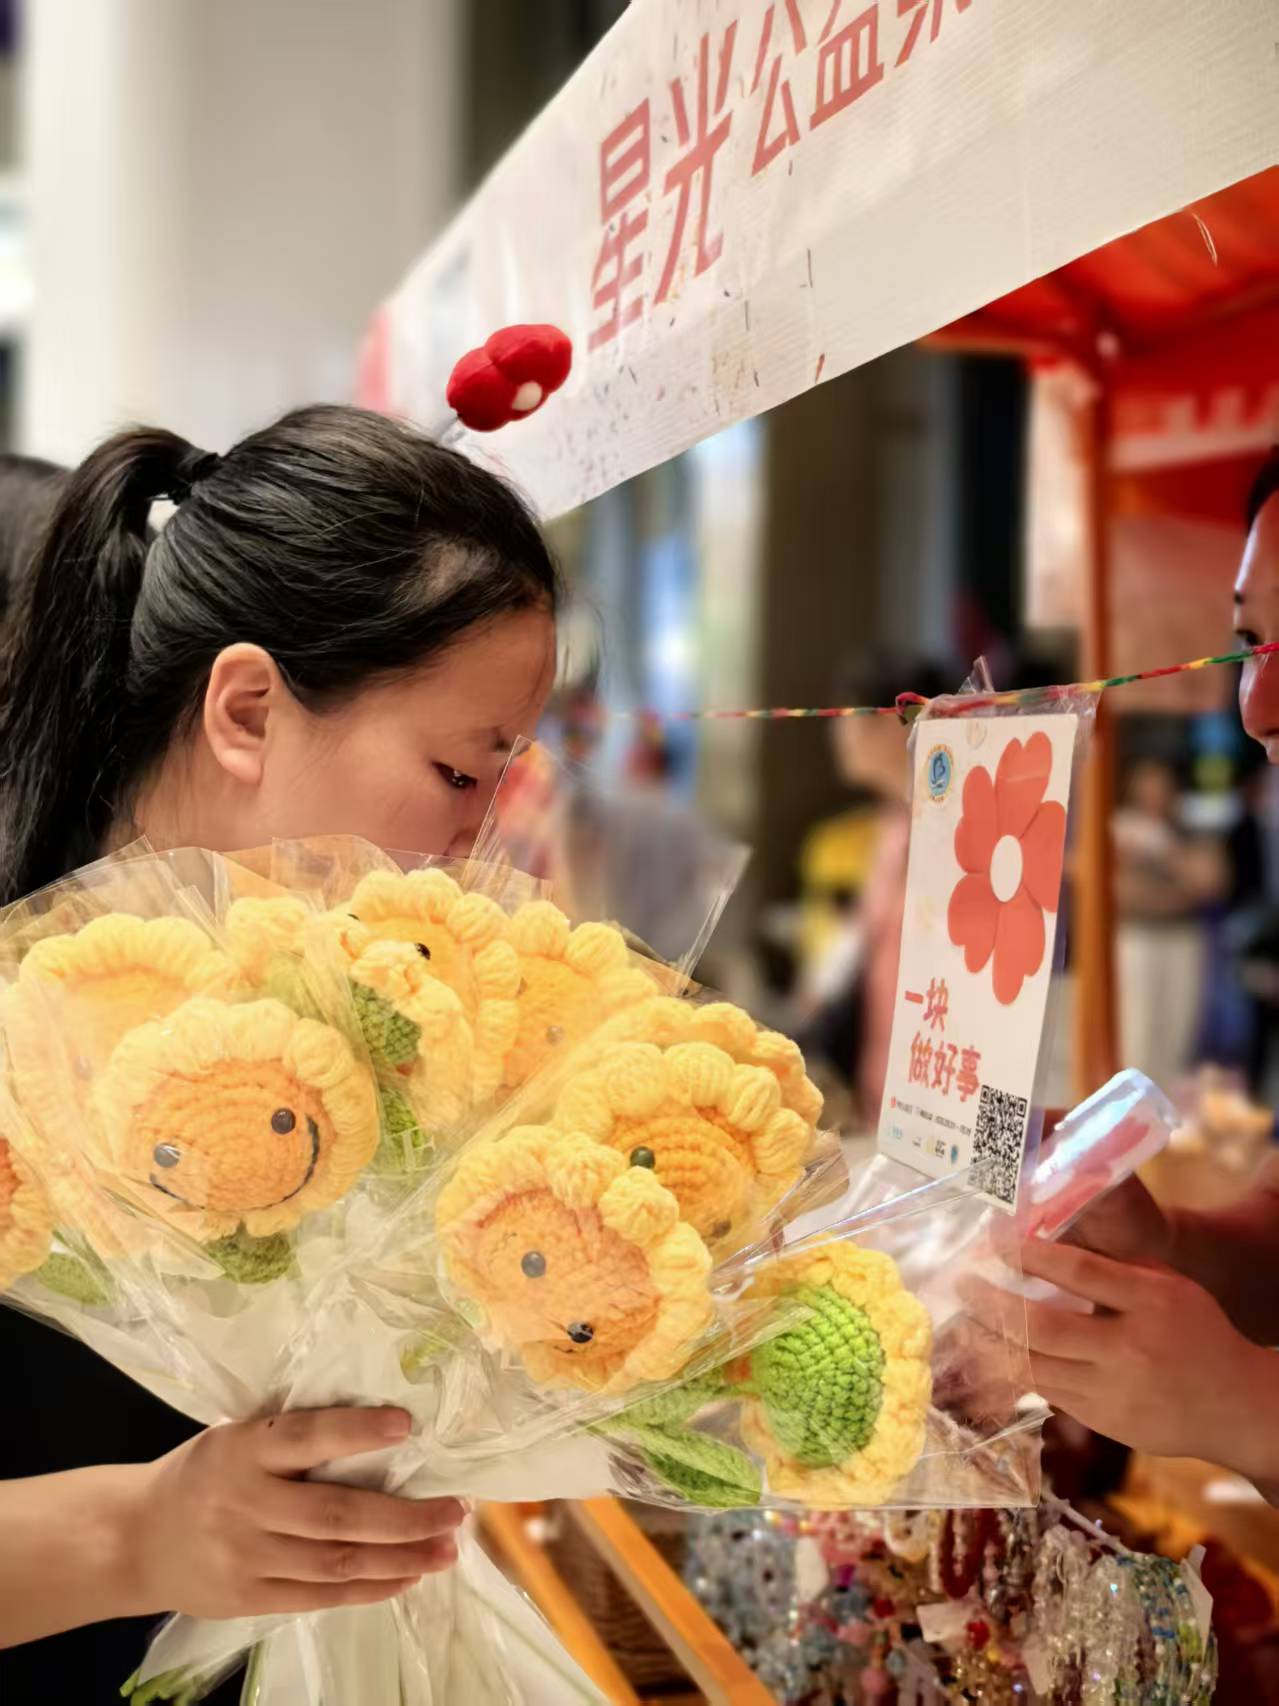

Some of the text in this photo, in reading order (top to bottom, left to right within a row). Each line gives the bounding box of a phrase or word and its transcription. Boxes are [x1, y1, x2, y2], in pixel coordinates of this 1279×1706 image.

[904, 978, 948, 1032] 一块
[907, 1031, 980, 1102] 做好事
